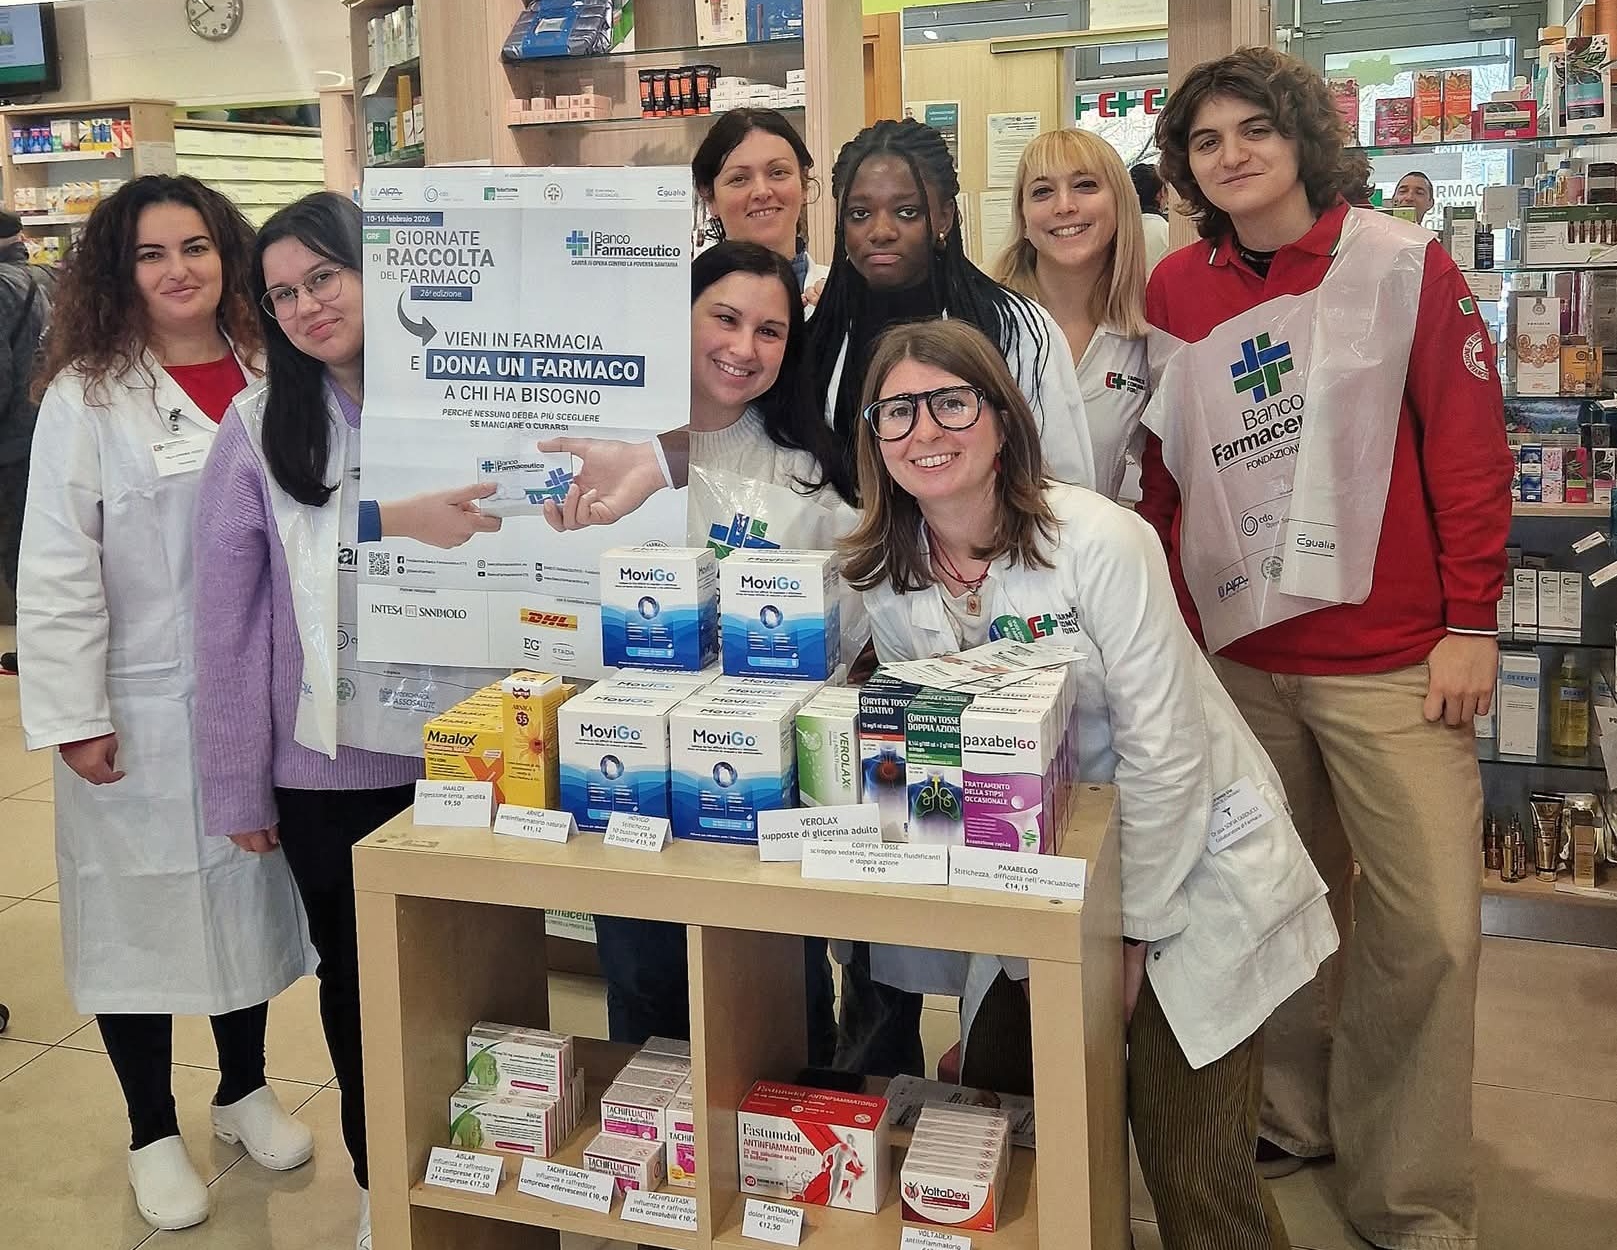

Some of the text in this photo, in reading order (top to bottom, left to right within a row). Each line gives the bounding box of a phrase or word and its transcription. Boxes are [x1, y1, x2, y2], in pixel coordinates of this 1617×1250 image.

[395, 230, 480, 246] GIORNATE
[594, 232, 630, 244] Banco
[594, 244, 680, 257] Farmaceutico
[372, 248, 495, 267] DI RACCOLTA
[380, 269, 481, 284] DEL FARMACO
[432, 290, 462, 298] edizione
[444, 331, 603, 350] VIENI IN FARMACIA
[410, 355, 639, 381] E DONA UN FARMACO
[444, 385, 601, 405] A CHI HA BISOGNO
[474, 410, 511, 419] NESSUNO
[512, 411, 539, 420] DEBBA
[541, 411, 555, 420] PIÙ
[556, 413, 600, 422] SCEGLIERE
[1242, 394, 1304, 430] Banco
[481, 421, 524, 429] MANGIARE
[533, 423, 569, 431] CURARSI
[497, 463, 544, 471] Farmaceutico
[1258, 514, 1273, 524] cdo
[620, 568, 676, 582] MoviGo
[741, 575, 801, 591] MoviGo
[371, 604, 403, 615] INTESA
[528, 612, 570, 627] DHL
[524, 638, 540, 650] EG
[861, 696, 889, 706] CORYFIN
[861, 706, 894, 715] SEDATIVO
[517, 715, 527, 724] 35
[908, 713, 959, 724] CORYFIN TOSSE
[580, 724, 640, 740] MoviGo
[908, 723, 961, 733] DOPPIA AZIONE
[428, 730, 477, 746] Maalox
[693, 729, 755, 746] MoviGo
[963, 734, 1036, 750] paxabelGO
[839, 732, 852, 788] VEROLAX
[964, 781, 1010, 790] TRATTAMENTO
[964, 788, 1004, 798] DELLA STIPSI
[964, 796, 1008, 805] OCCASIONALE
[800, 817, 838, 826] VEROLAX
[619, 828, 639, 836] bustine
[761, 826, 878, 841] supposte di glicerina adulto
[616, 835, 635, 843] bustine
[855, 858, 877, 866] doppia
[998, 864, 1038, 875] PAXABELGO
[993, 872, 1023, 883] difficoltà
[1005, 882, 1029, 892] €14,15
[808, 1094, 878, 1108] ANTINFIAMMATORIO
[606, 1105, 655, 1120] TACHIFLUACTIV
[743, 1122, 800, 1142] Fastumdol
[744, 1139, 815, 1156] ANTINFIAMMATORIO
[455, 1153, 475, 1161] AISLAR
[433, 1158, 457, 1167] influenza
[463, 1164, 495, 1173] raffreddore
[588, 1157, 638, 1175] TACHIFLUACTIV
[442, 1168, 471, 1178] compresse
[473, 1172, 490, 1180] €7,10
[547, 1165, 589, 1179] TACHIFLUACTIV
[439, 1176, 468, 1186] compresse
[470, 1181, 489, 1189] €17,50
[536, 1172, 560, 1182] influenza
[566, 1179, 596, 1190] raffreddore
[521, 1178, 609, 1202] compresse effervescenti €10,40
[921, 1185, 969, 1200] VoltaDexi
[634, 1199, 660, 1209] influenza
[648, 1193, 690, 1204] TACHIFLUTASK
[645, 1210, 677, 1220] orosolubili
[763, 1204, 799, 1216] FASTUMDOL
[759, 1221, 781, 1230] €12,50
[767, 1215, 794, 1225] articolari
[918, 1230, 952, 1240] VOLTADEXI
